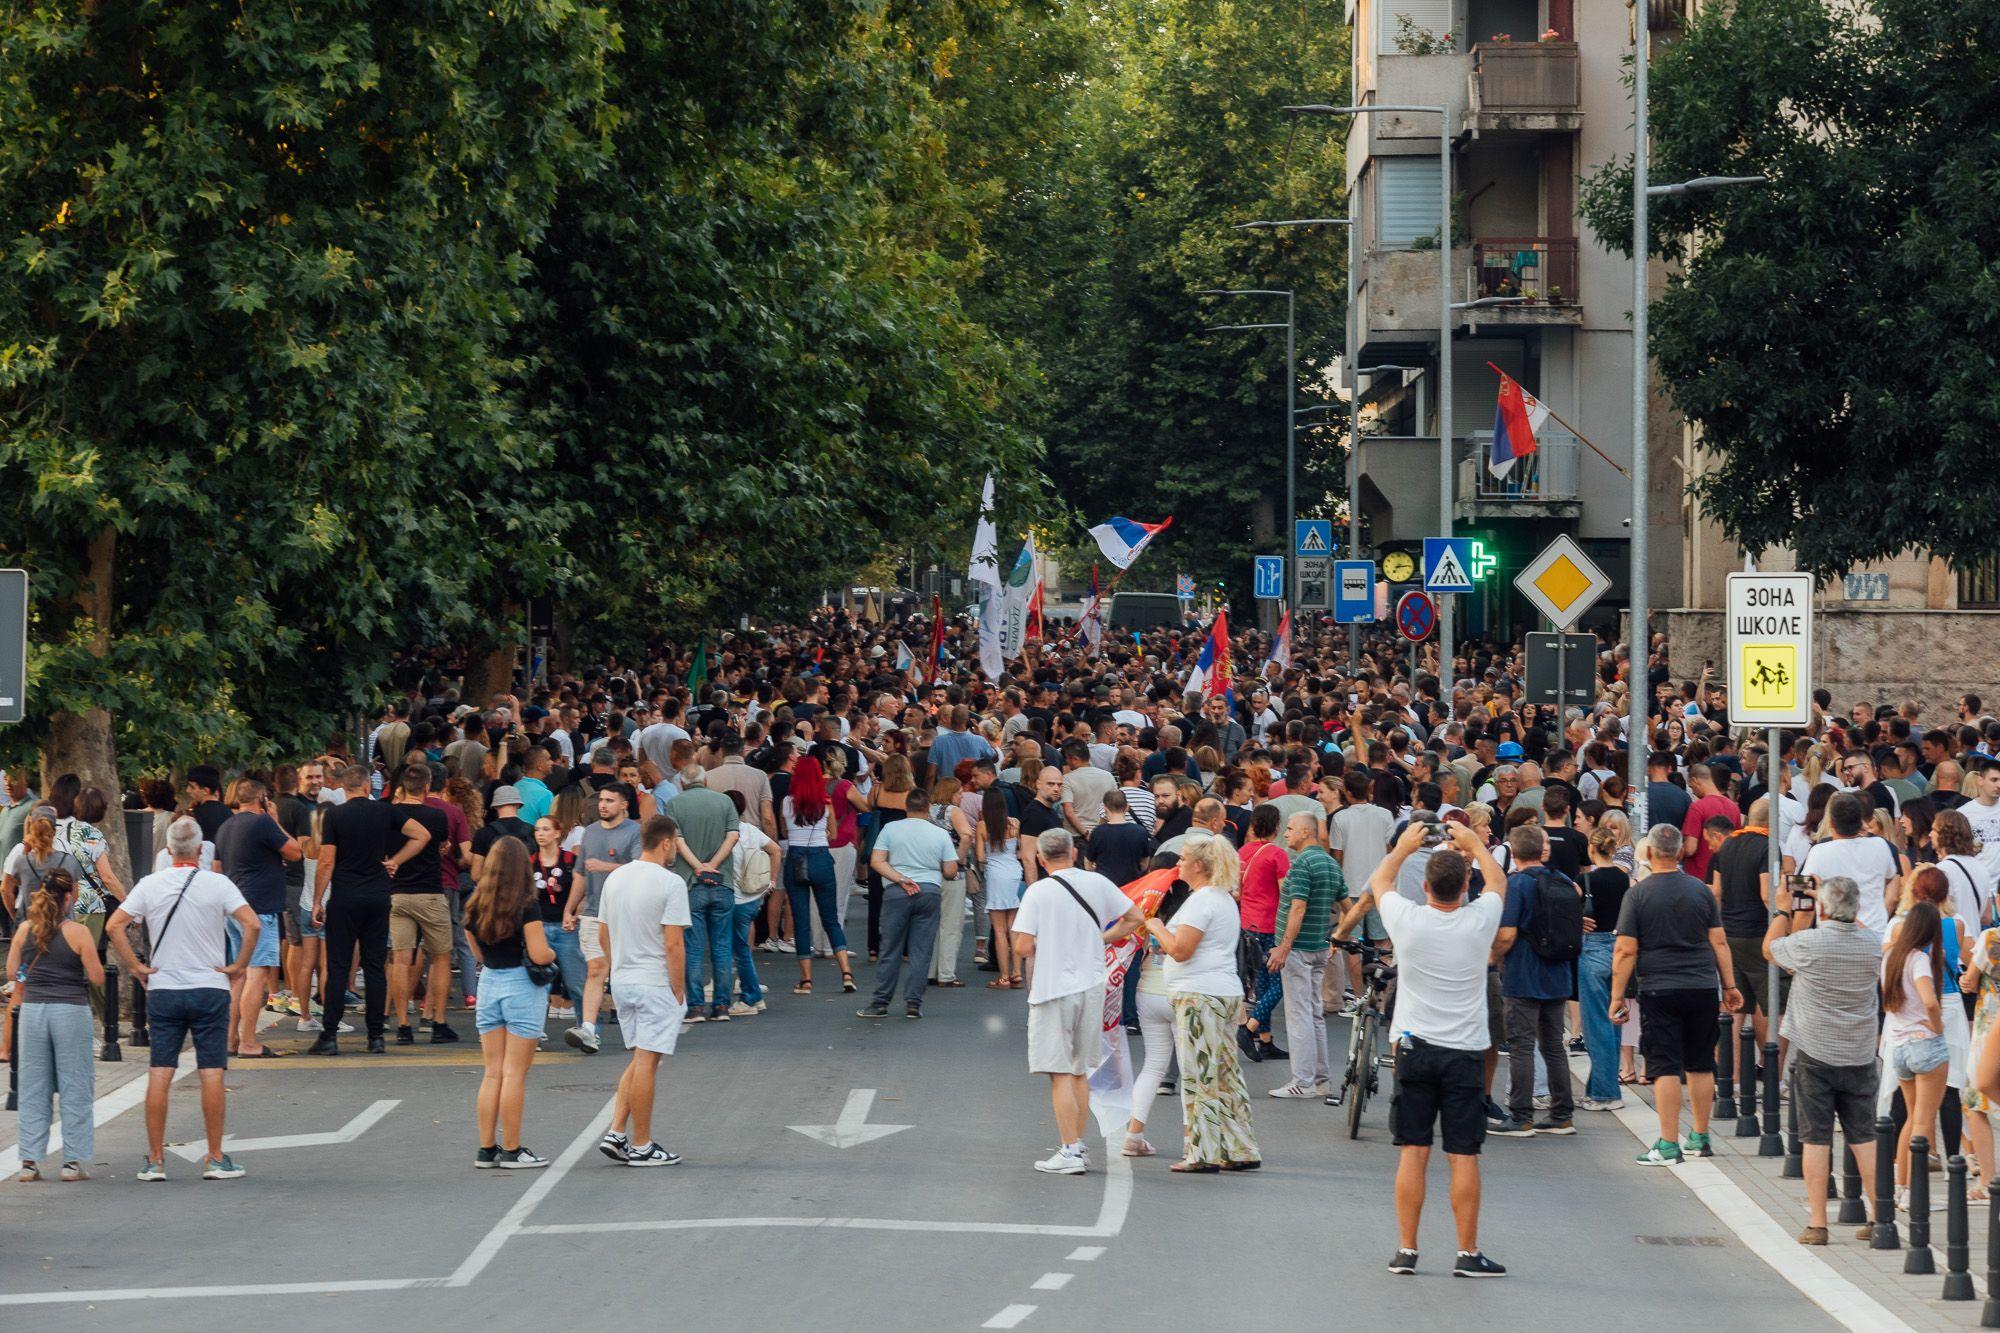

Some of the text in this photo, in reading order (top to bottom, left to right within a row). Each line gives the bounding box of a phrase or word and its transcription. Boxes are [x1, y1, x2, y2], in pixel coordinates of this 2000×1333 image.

[1303, 560, 1326, 569] ЗОНА
[1300, 570, 1327, 578] ШКОЛЕ
[1746, 588, 1795, 606] ЗОНА
[1737, 616, 1801, 635] ШКОЛЕ
